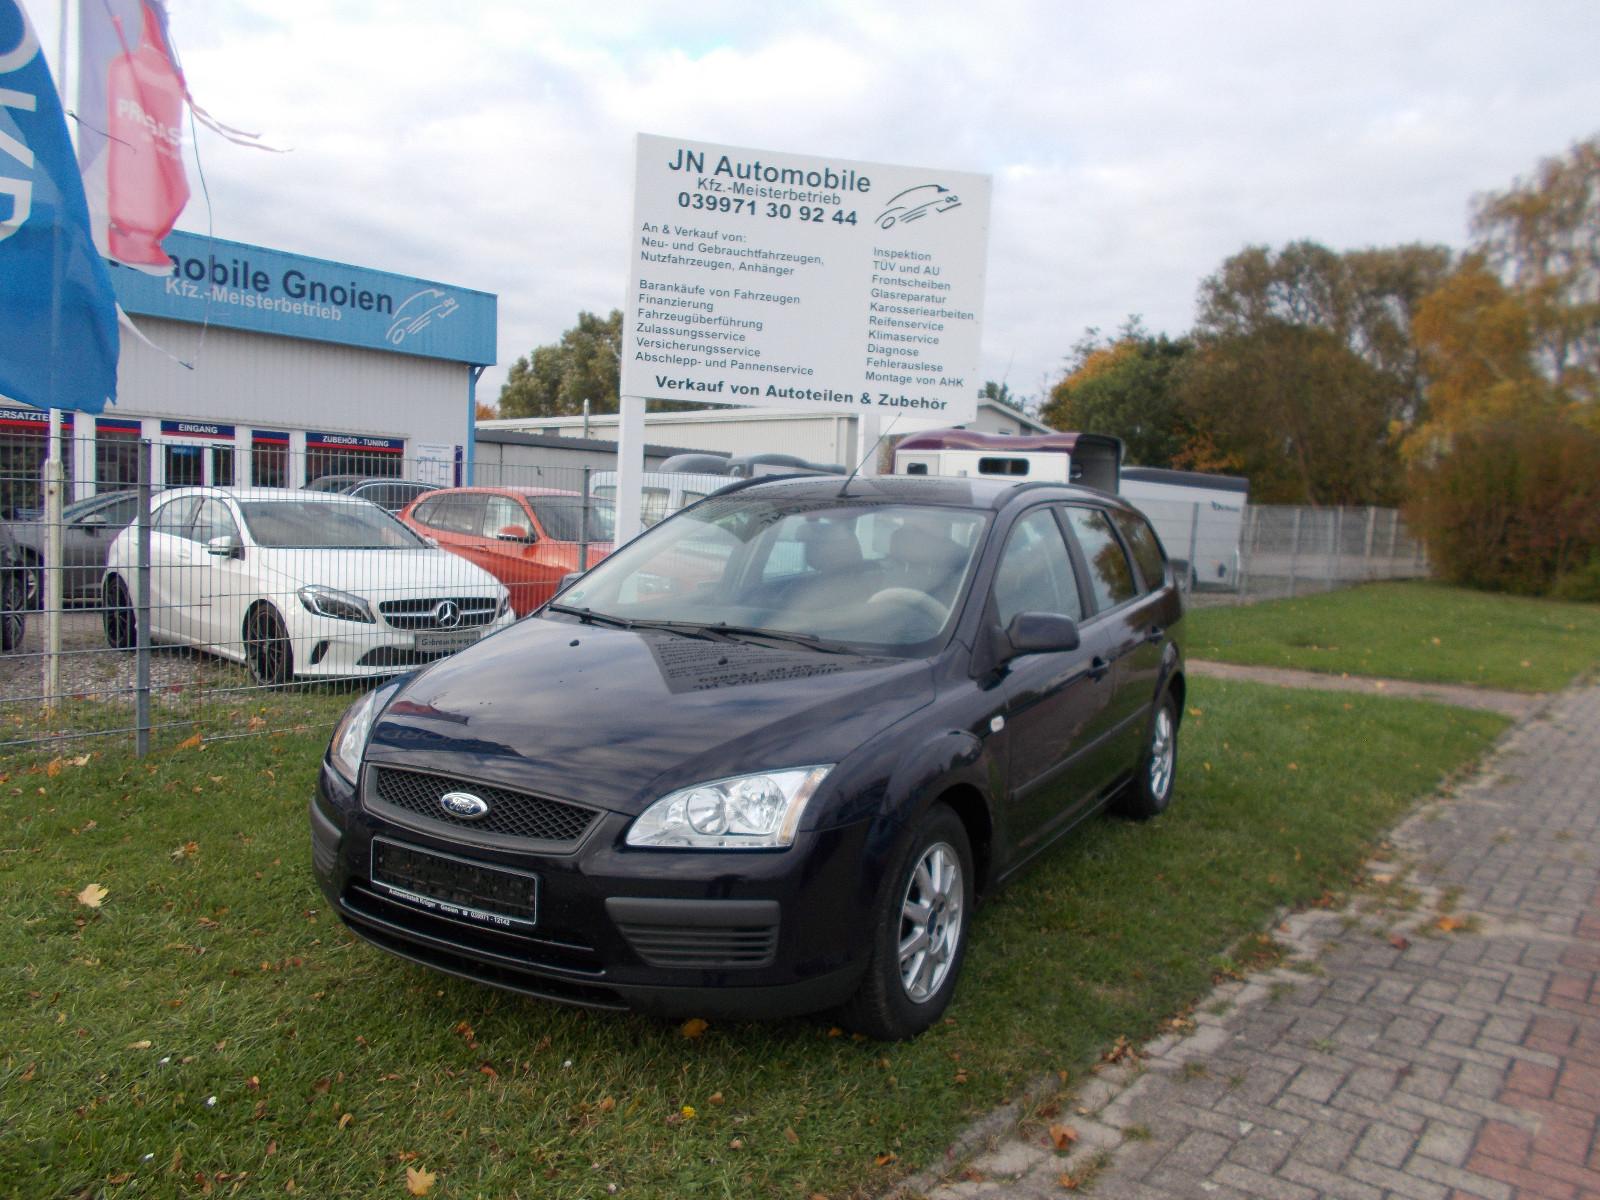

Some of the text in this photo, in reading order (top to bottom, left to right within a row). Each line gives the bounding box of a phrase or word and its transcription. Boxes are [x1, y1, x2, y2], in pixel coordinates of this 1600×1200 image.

[668, 149, 871, 192] JN Automobile
[698, 177, 841, 206] Kfz.-Meisterbetrieb
[678, 192, 858, 226] 039971 30 92 44
[642, 222, 747, 243] An & Verkauf von:
[641, 237, 825, 265] Neu- und Gebrauchtfahrzeugen,
[873, 247, 932, 261] Inspektion
[640, 251, 795, 277] Nutzfahrzeugen, Anhänger
[872, 259, 940, 276] TÜV und AU
[282, 270, 393, 314] Gnoien
[639, 279, 800, 305] Barankäufe von Fahrzeugen
[871, 274, 951, 291] Frontscheiben
[165, 277, 342, 322] Kfz.-Meisterbetrieb
[638, 294, 714, 312] Finanzierung
[870, 288, 947, 304] Glasreparatur
[637, 308, 763, 331] Fahrzeugüberführung
[870, 302, 974, 320] Karosseriearbeiten
[636, 322, 746, 342] Zulassungsservice
[869, 315, 944, 331] Reifenservice
[636, 337, 761, 357] Versicherungsservice
[868, 329, 940, 345] Klimaservice
[867, 343, 919, 357] Diagnose
[635, 352, 814, 376] Abschlepp- und Pannenservice
[866, 357, 943, 372] Fehlerauslese
[865, 371, 964, 387] Montage von AHK
[655, 375, 948, 411] Verkauf von Autoteilen & Zubehör
[178, 423, 218, 434] EINGANG
[322, 435, 358, 445] ZUBEHÖR
[364, 439, 389, 448] TUNING
